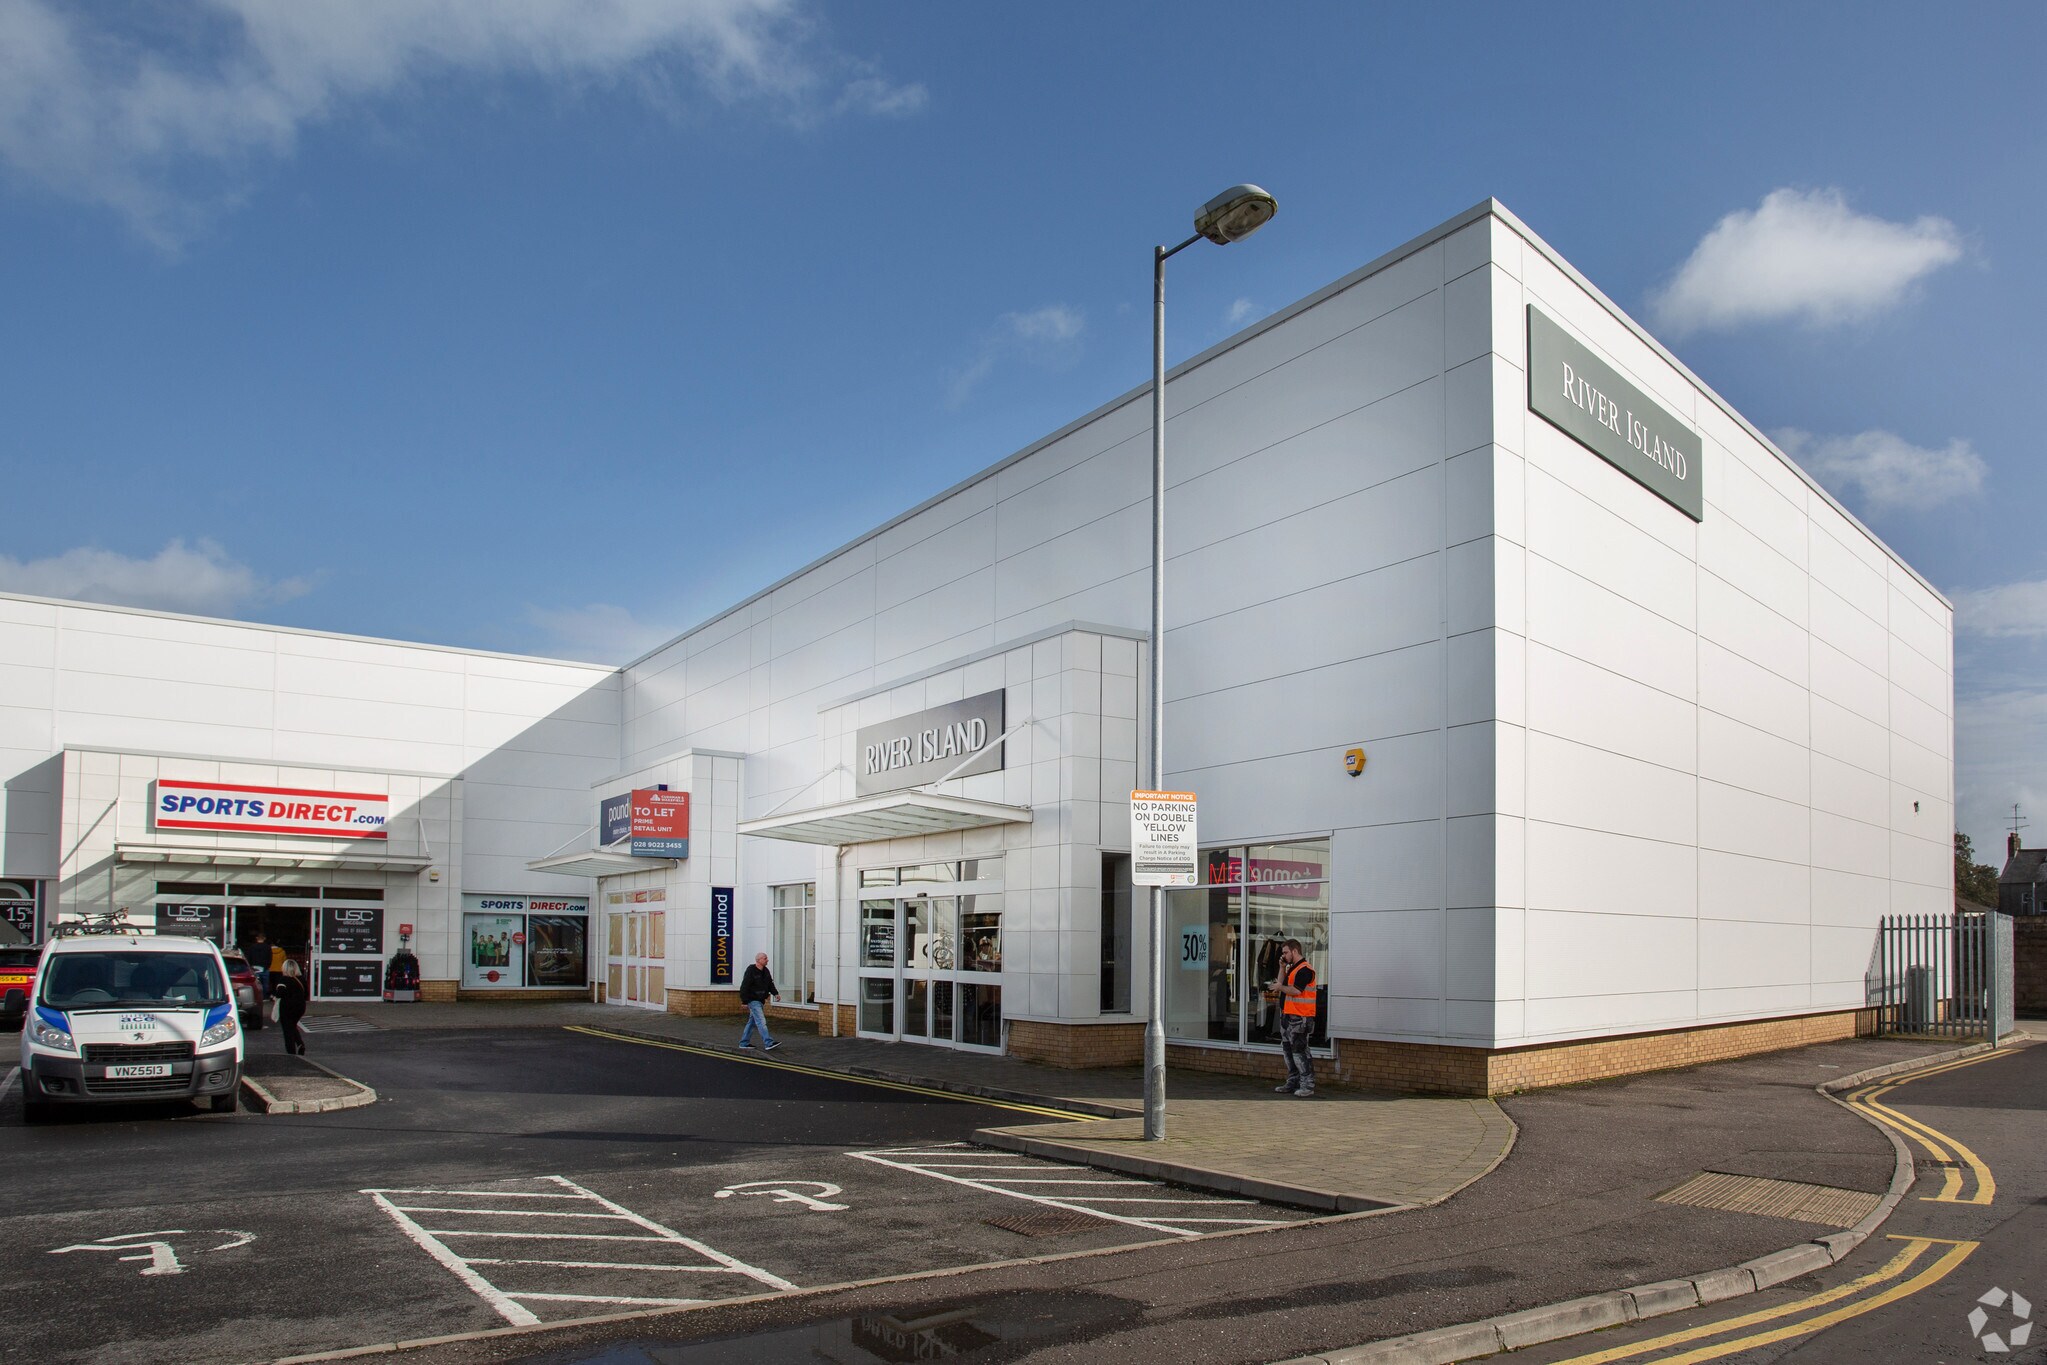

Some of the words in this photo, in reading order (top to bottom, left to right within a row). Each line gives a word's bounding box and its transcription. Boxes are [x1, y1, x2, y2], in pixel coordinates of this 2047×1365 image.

[1561, 361, 1621, 436] RIVER
[1626, 410, 1687, 481] ISLAND
[865, 736, 913, 775] RIVER
[917, 717, 988, 764] ISLAND
[161, 794, 264, 817] SPORTS
[1151, 803, 1196, 812] PARKING
[634, 807, 650, 816] TO
[654, 808, 675, 817] LET
[1153, 813, 1194, 822] DOUBLE
[1143, 823, 1186, 832] YELLOW
[1151, 833, 1179, 842] LINES
[481, 900, 524, 909] SPORTS
[530, 901, 586, 911] DIRECT.COM
[167, 905, 211, 918] USC
[335, 910, 374, 921] USC
[715, 894, 730, 976] poundworld
[1199, 952, 1207, 961] OFF
